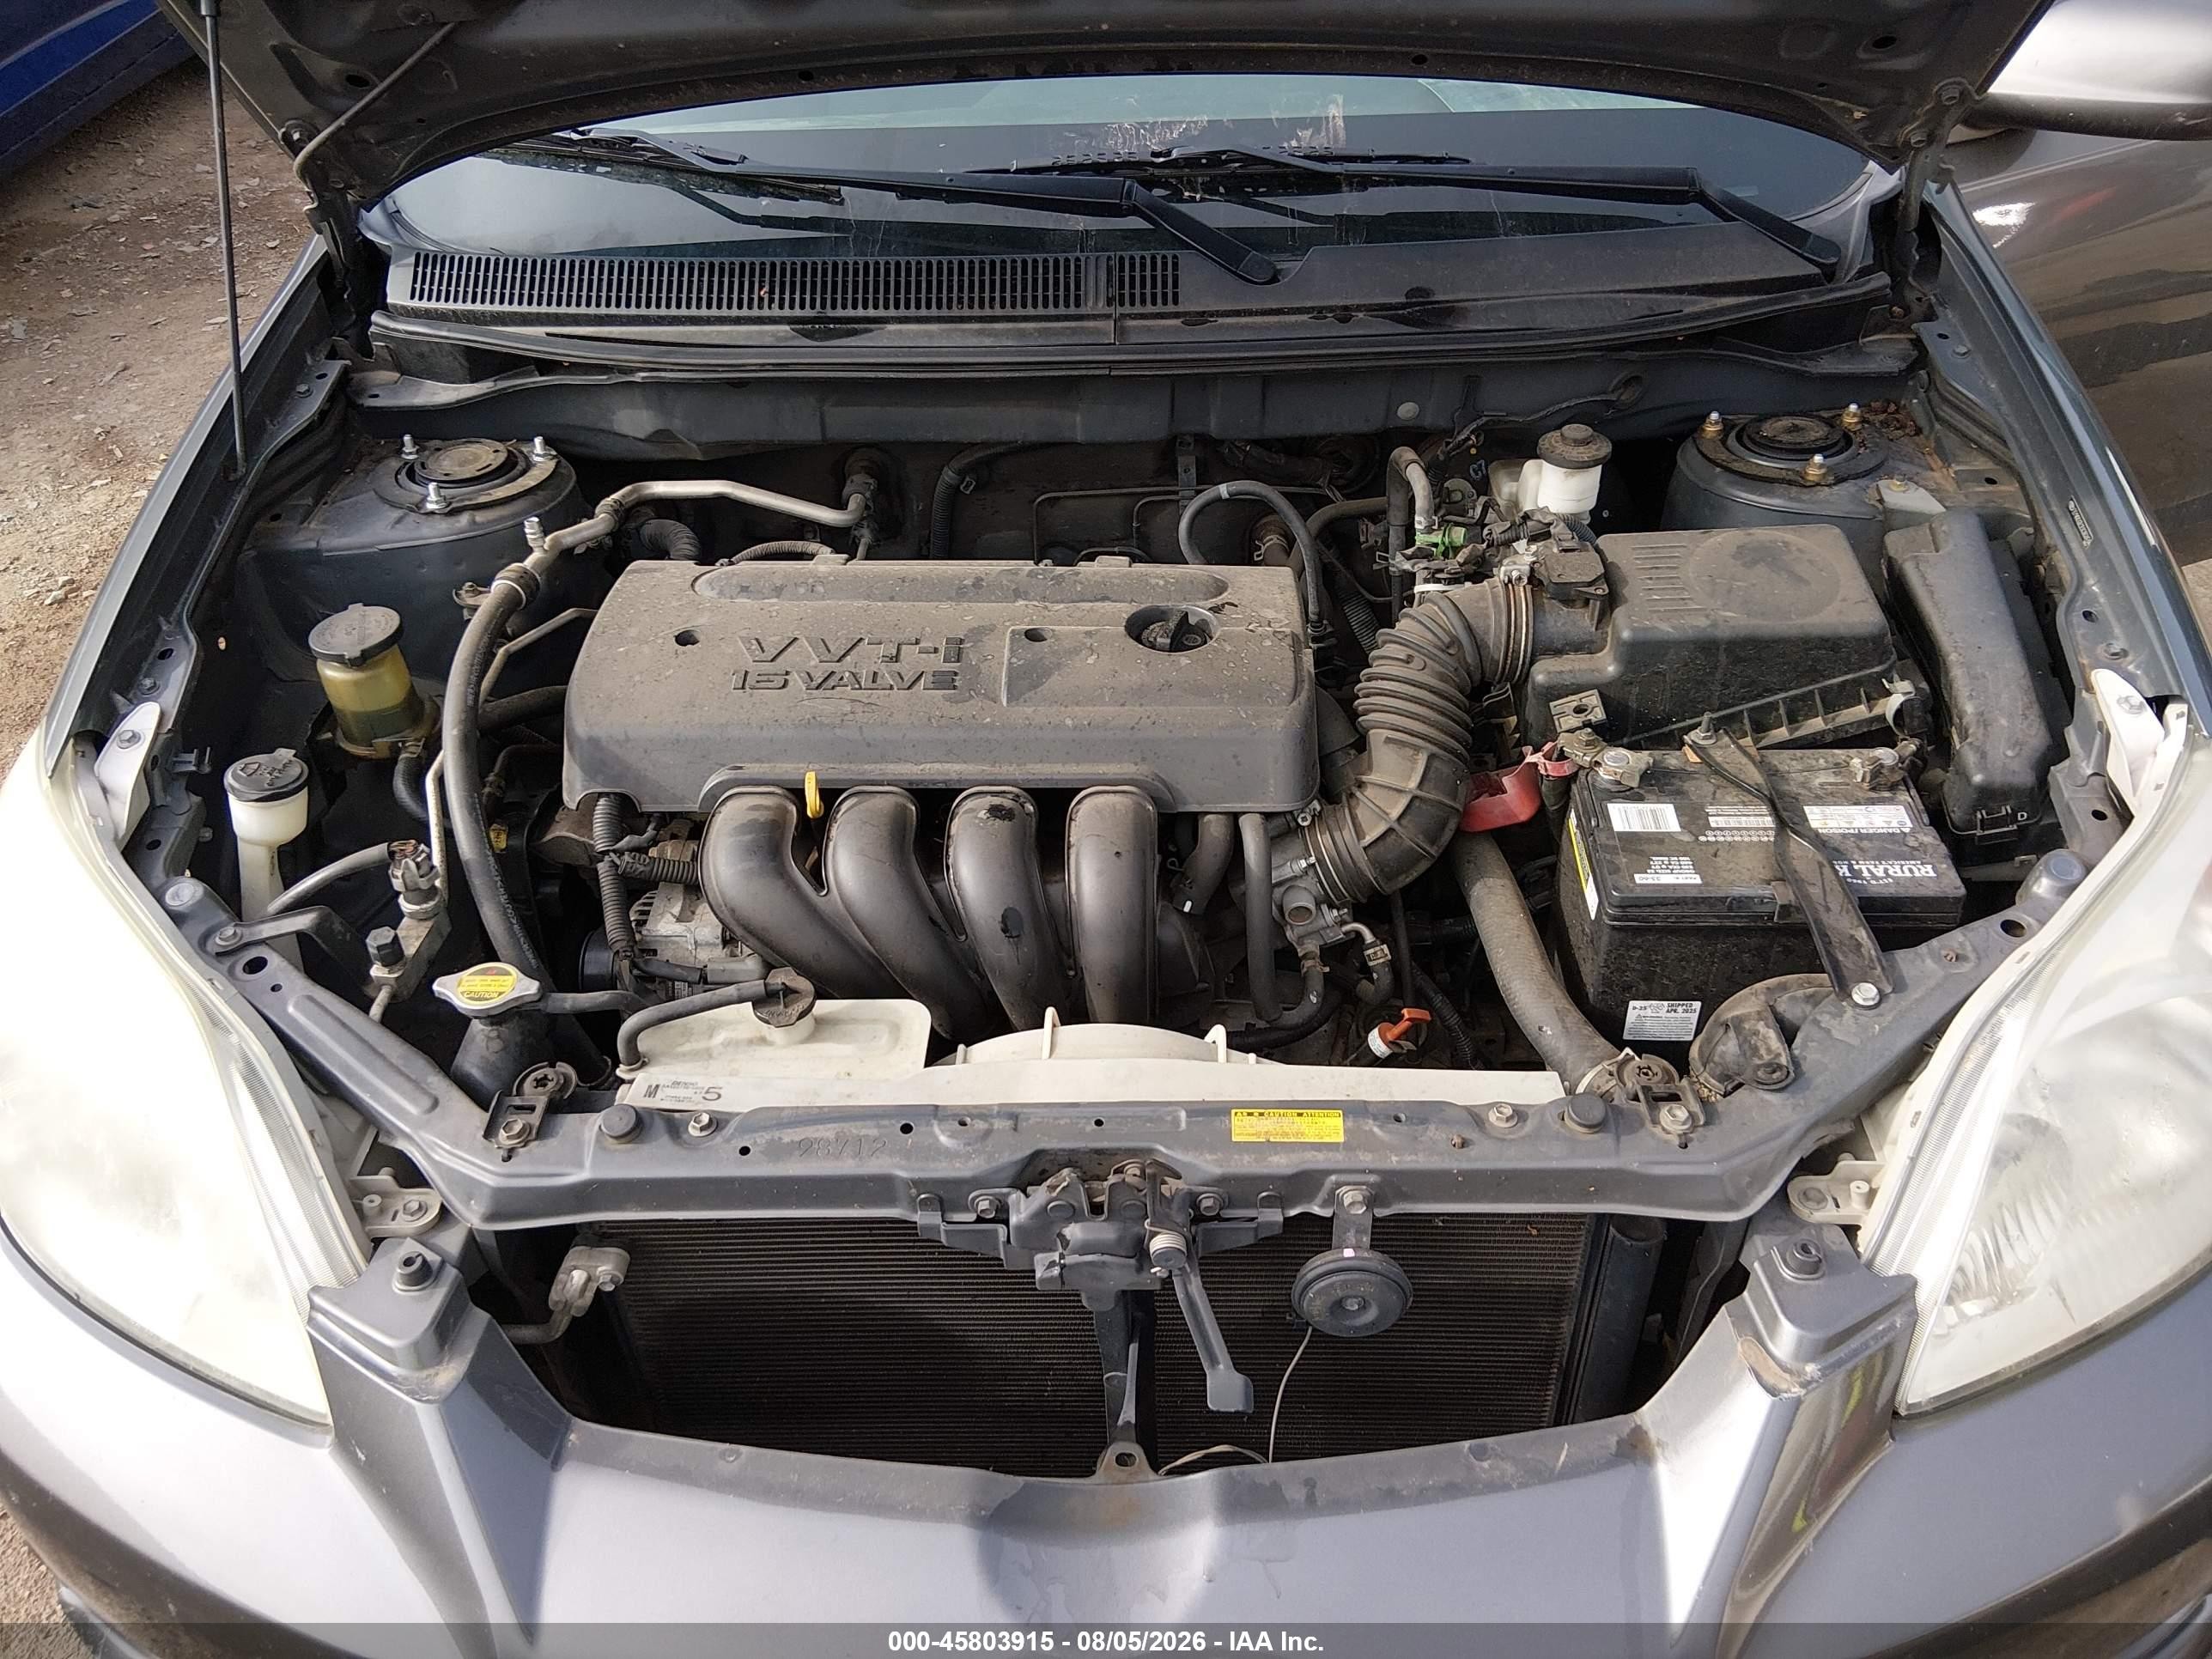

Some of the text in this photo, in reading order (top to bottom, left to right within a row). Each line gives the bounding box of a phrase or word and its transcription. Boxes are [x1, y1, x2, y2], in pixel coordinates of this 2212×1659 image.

[792, 669, 960, 690] VALVE
[2017, 811, 2027, 822] D
[1853, 865, 1938, 877] RURAL
[643, 1084, 660, 1098] M
[702, 1086, 723, 1101] 5
